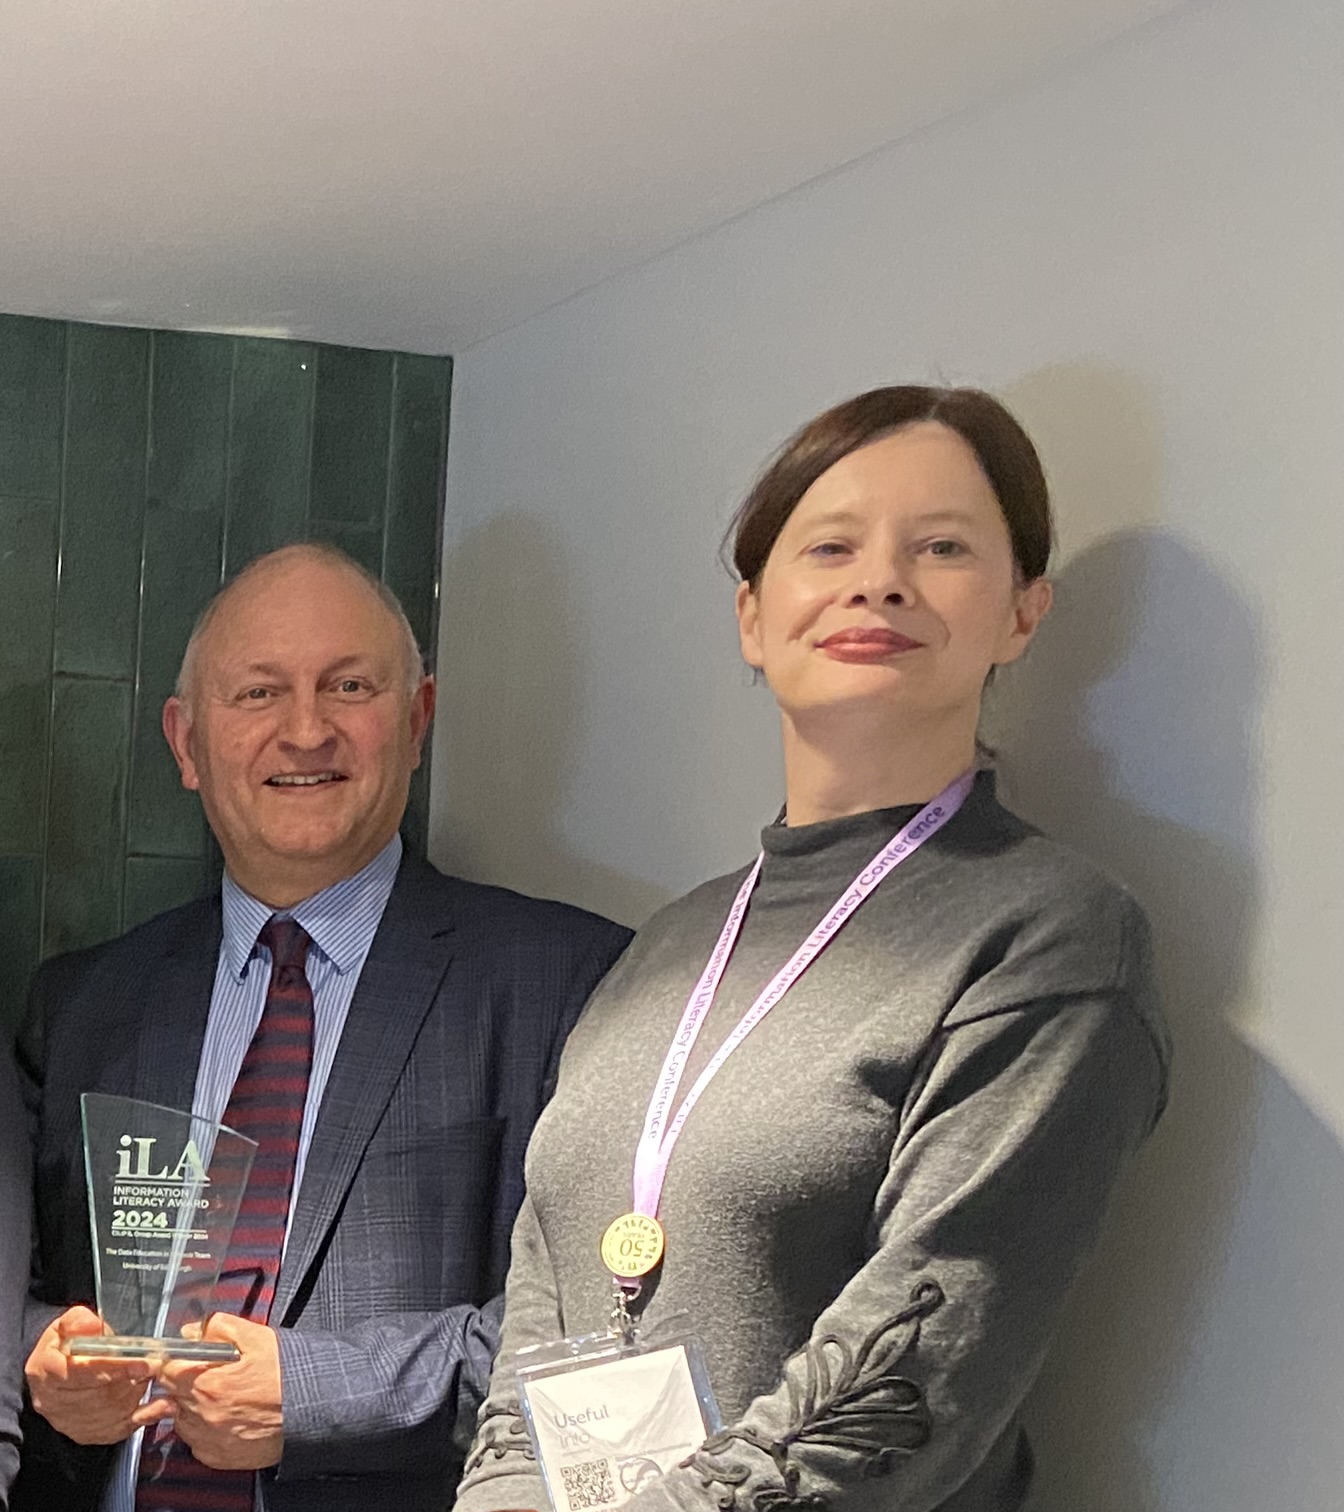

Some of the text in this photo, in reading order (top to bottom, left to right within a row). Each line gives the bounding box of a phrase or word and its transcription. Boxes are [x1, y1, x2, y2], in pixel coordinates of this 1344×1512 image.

[807, 889, 862, 948] Literacy
[859, 806, 945, 886] Conference
[677, 991, 712, 1047] Literacy
[648, 1050, 686, 1140] Conference
[115, 1134, 211, 1181] iLA
[113, 1185, 190, 1198] INFORMATION
[113, 1196, 209, 1209] LITERACY AWARD
[112, 1209, 169, 1229] 2024
[619, 1238, 645, 1257] 50
[554, 1404, 610, 1429] Useful
